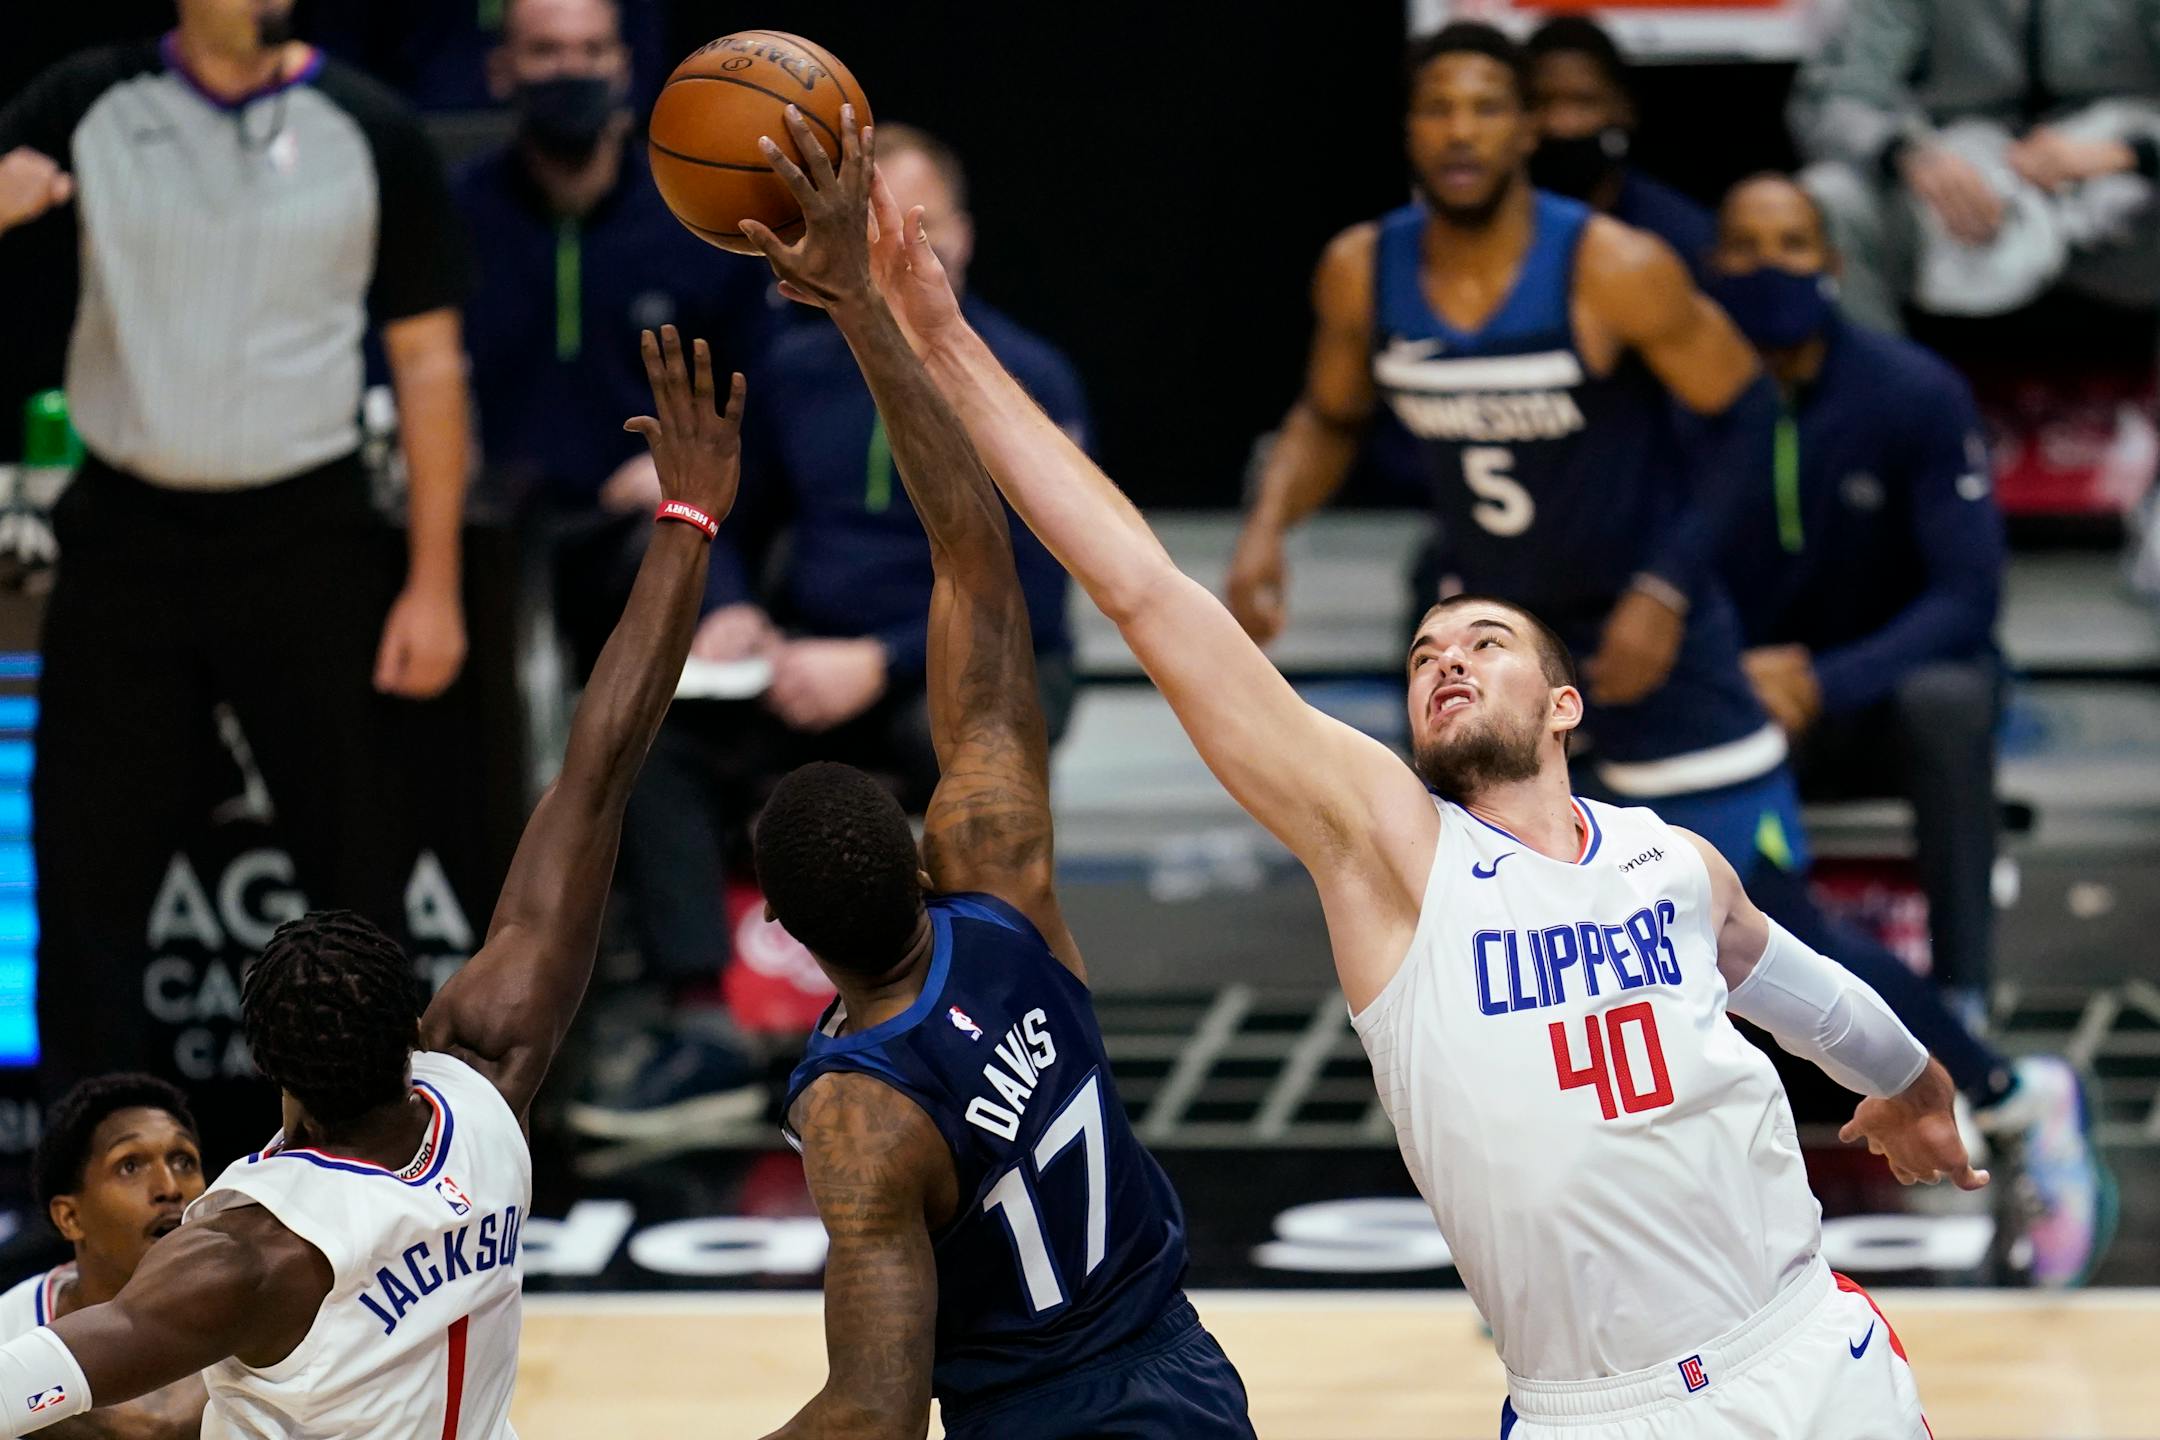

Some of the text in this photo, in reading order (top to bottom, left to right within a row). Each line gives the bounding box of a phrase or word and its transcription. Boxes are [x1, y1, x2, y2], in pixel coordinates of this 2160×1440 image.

[664, 503, 709, 526] HENRY
[1461, 445, 1536, 537] 5
[147, 848, 475, 951] AGA
[1472, 898, 1683, 1016] CLIPPERS
[965, 1007, 1058, 1142] DAVIS
[1547, 1001, 1675, 1121] 40
[982, 1073, 1107, 1313] 17
[441, 1313, 470, 1440] 1
